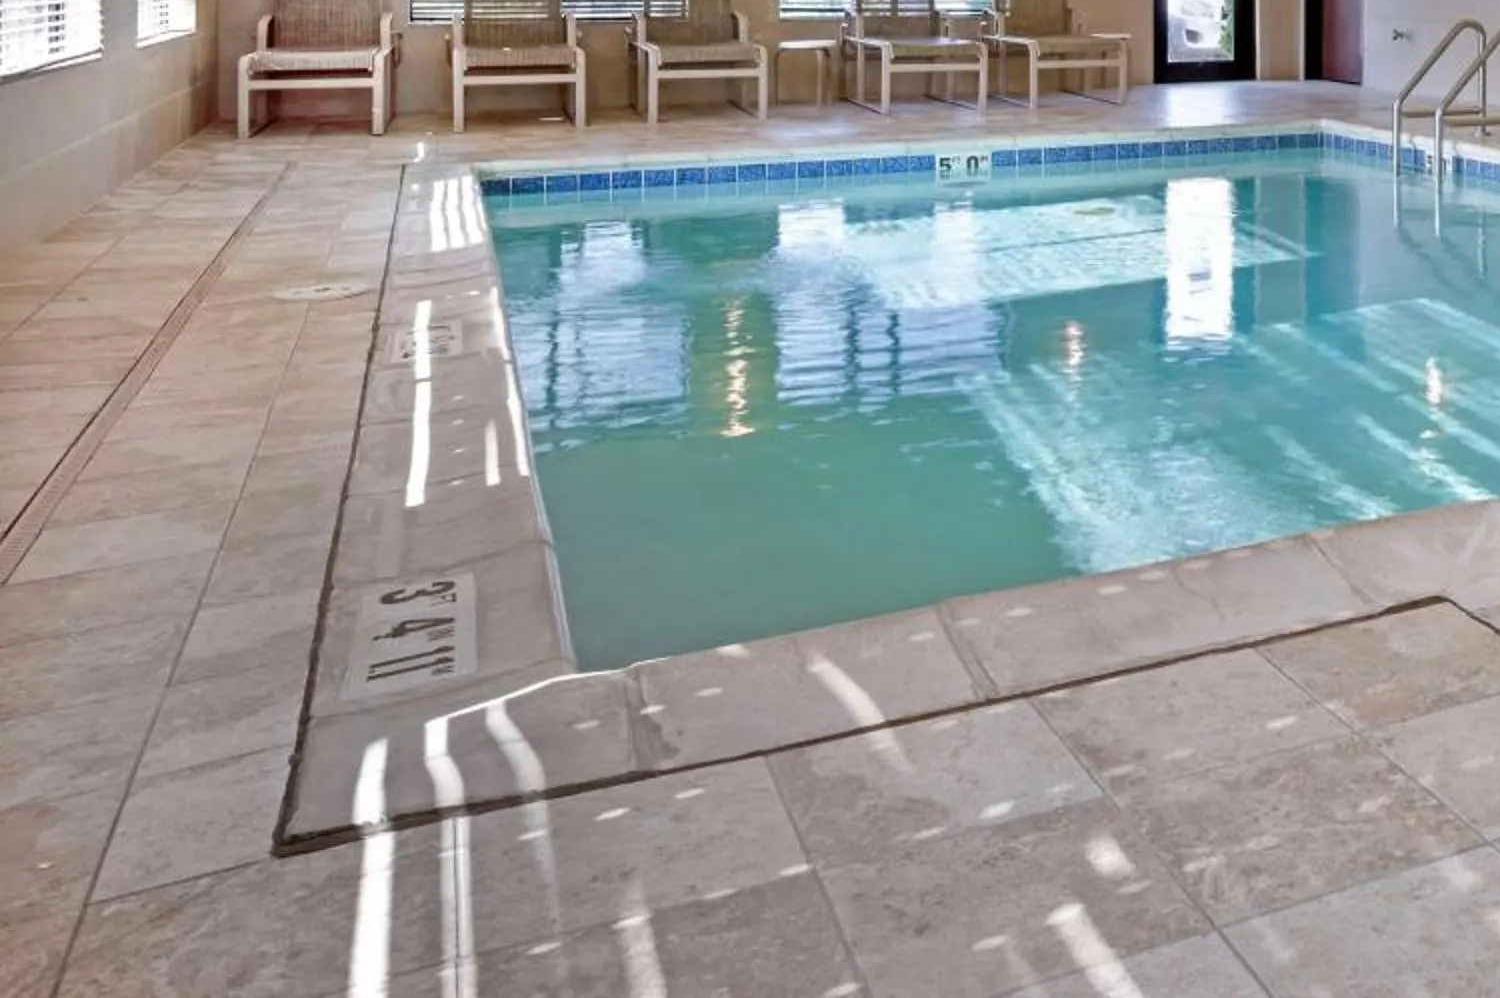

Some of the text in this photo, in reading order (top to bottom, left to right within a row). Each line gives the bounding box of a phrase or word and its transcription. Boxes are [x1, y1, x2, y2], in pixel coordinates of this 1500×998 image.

[939, 156, 952, 171] 5
[380, 581, 455, 605] 3
[372, 617, 455, 641] 4
